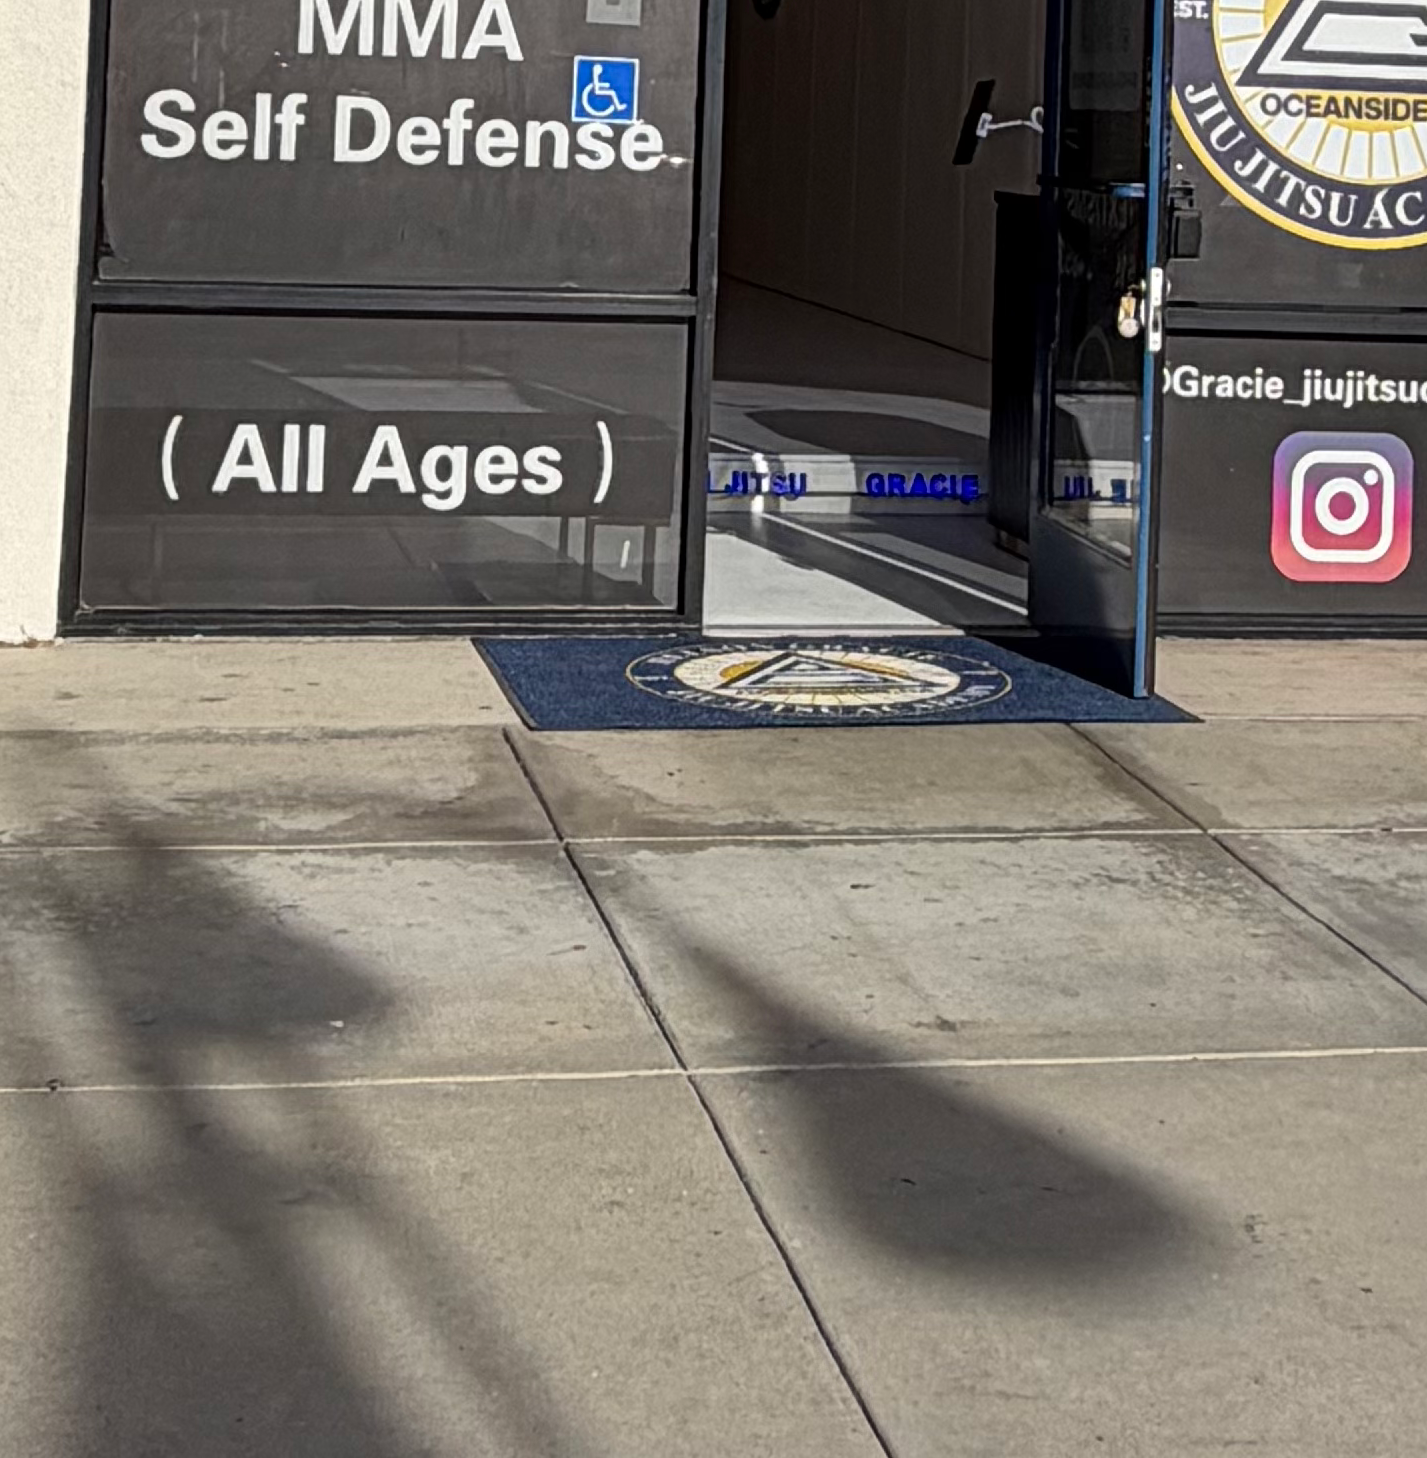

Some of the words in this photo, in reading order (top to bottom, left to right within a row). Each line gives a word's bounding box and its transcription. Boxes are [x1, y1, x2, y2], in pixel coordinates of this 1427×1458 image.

[141, 88, 308, 162] Self
[333, 94, 664, 173] Defense
[1185, 82, 1241, 153] JIU
[1234, 147, 1359, 228] JITSU
[211, 424, 326, 493] All
[352, 424, 563, 511] Ages
[724, 470, 807, 497] JITSU
[866, 472, 979, 504] GRACIE
